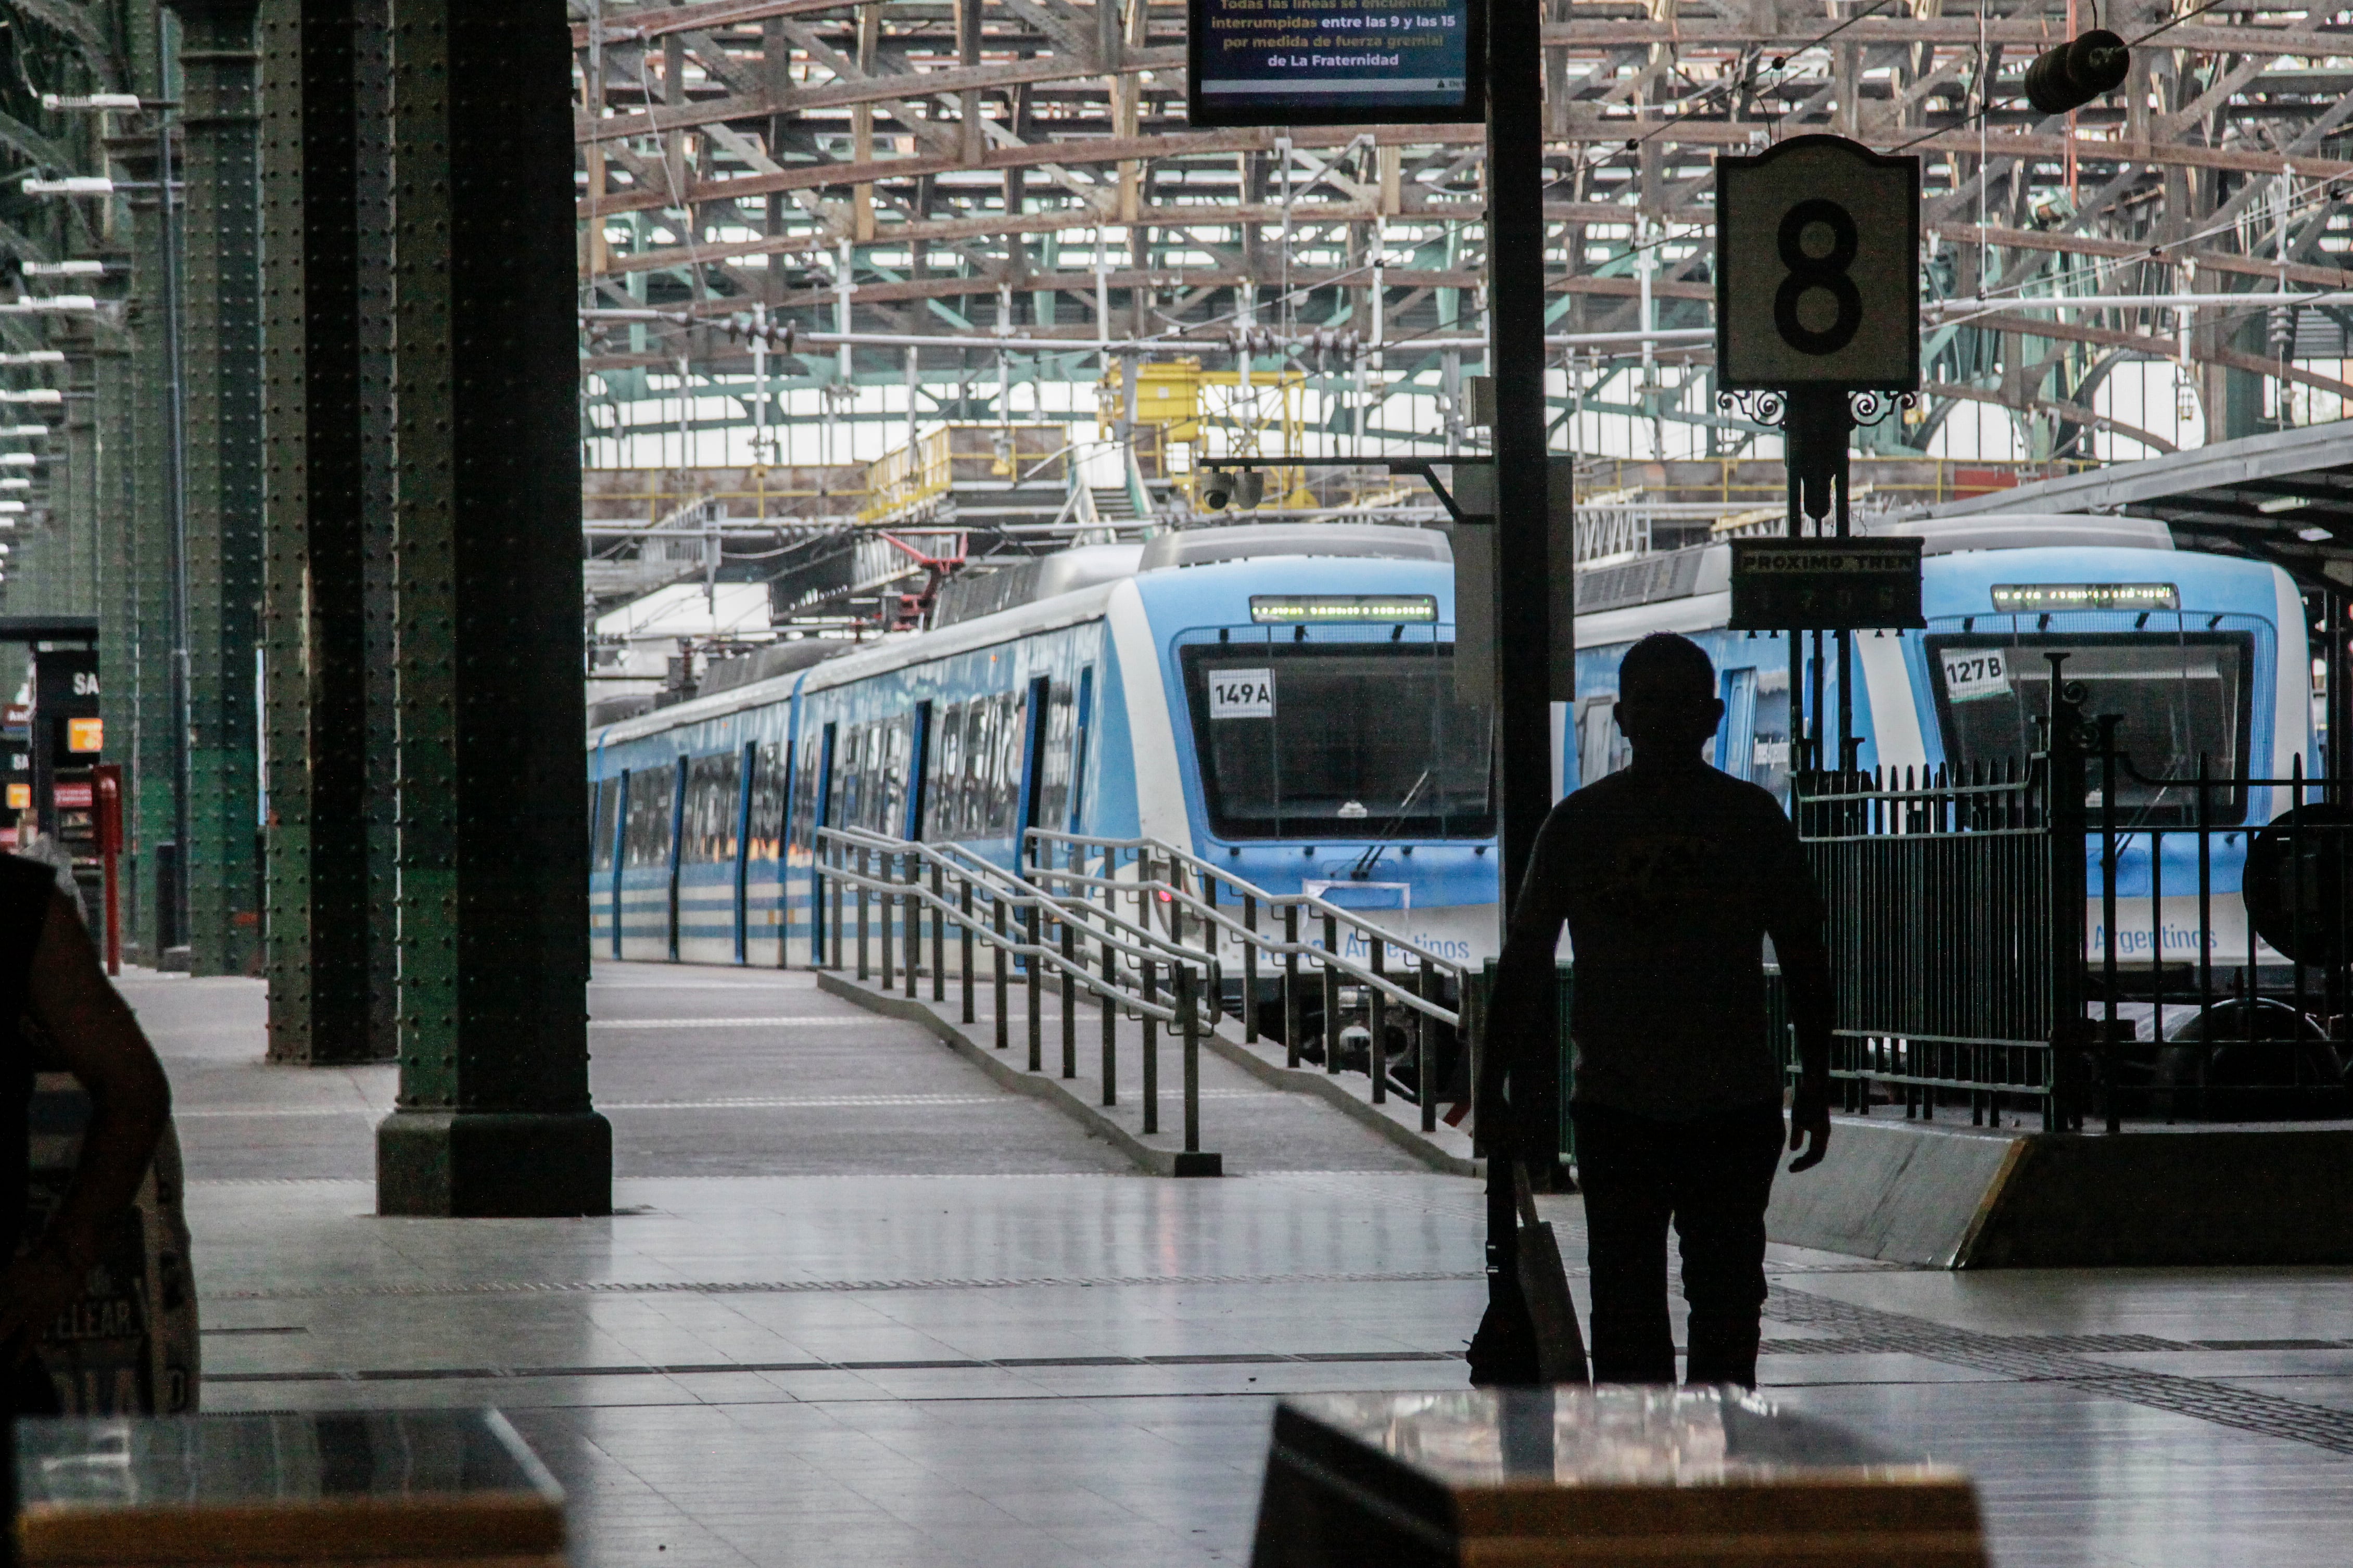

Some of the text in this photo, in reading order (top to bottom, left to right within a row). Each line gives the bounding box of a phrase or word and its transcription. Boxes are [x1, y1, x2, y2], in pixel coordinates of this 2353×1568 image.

[1220, 0, 1263, 9] Todas
[1268, 0, 1288, 9] las
[1340, 0, 1357, 8] se
[1361, 0, 1447, 8] encuentran
[1212, 15, 1456, 30] interrumpidas entre las 9 y las 15
[1224, 34, 1444, 51] por medida de fuerza gremial
[1268, 53, 1399, 67] de La Fraternidad
[1774, 199, 1862, 355] 8
[1743, 555, 1914, 569] PROXIMO TREN
[1946, 657, 2002, 684] 127B
[1216, 682, 1270, 705] 149A
